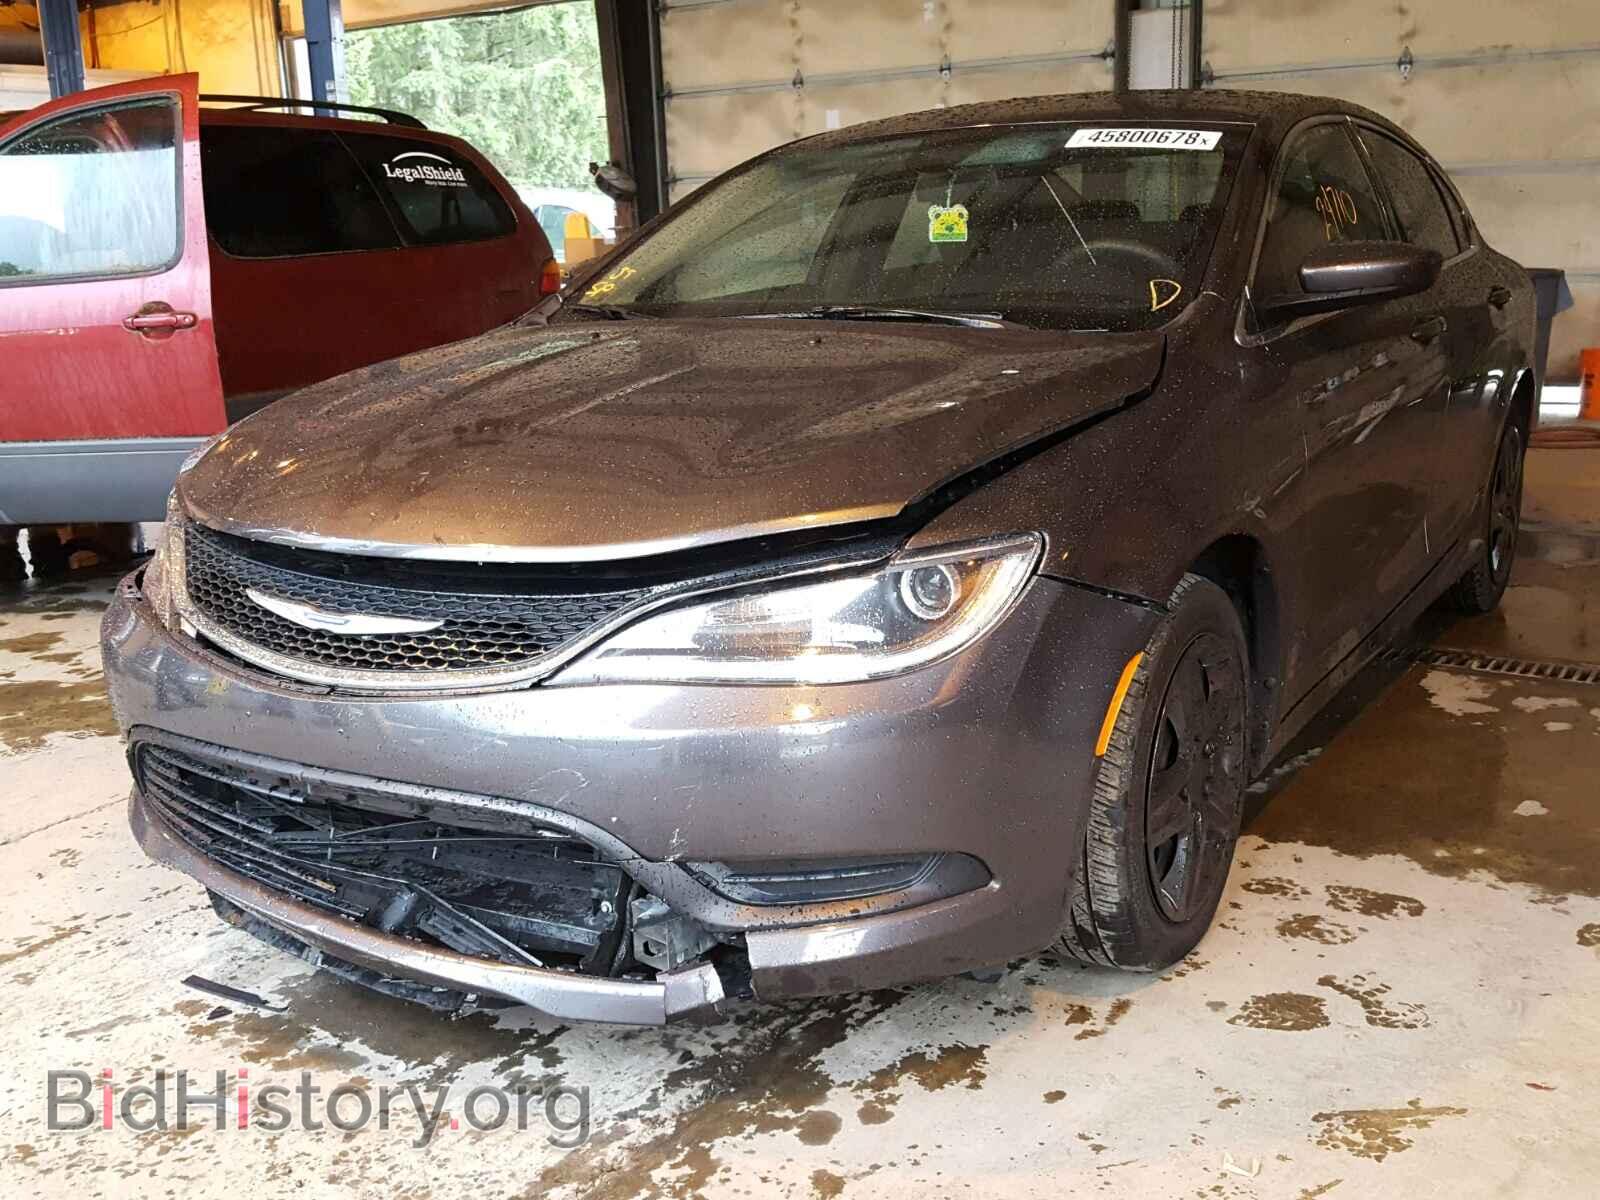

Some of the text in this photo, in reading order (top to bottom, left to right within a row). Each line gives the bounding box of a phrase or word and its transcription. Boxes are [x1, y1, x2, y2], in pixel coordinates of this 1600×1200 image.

[1088, 130, 1200, 145] 45800678
[382, 163, 465, 182] LegalShield
[1150, 279, 1182, 311] D
